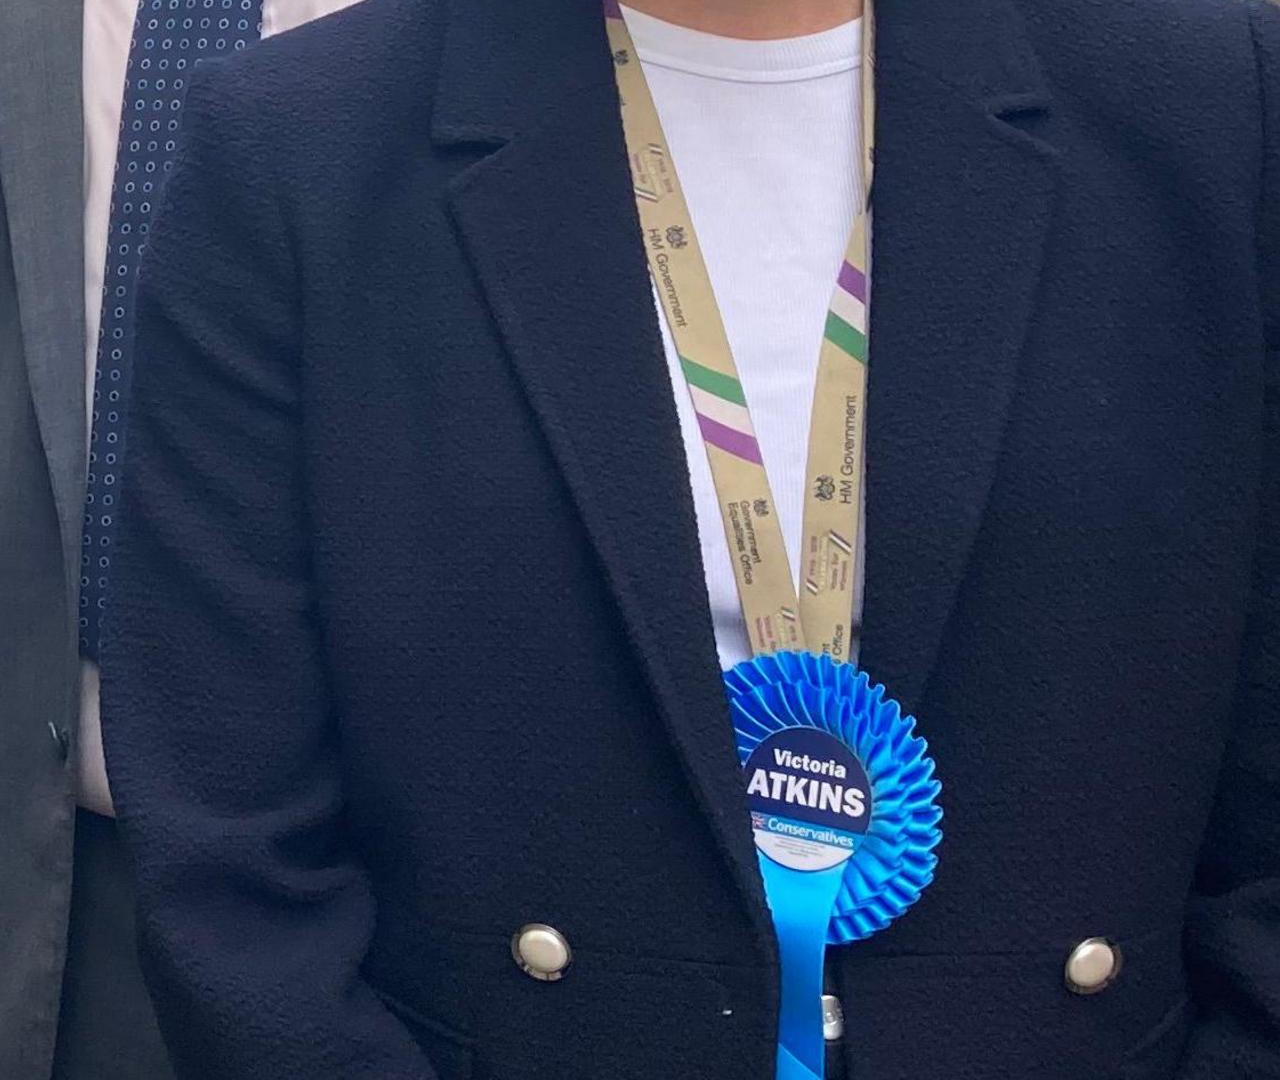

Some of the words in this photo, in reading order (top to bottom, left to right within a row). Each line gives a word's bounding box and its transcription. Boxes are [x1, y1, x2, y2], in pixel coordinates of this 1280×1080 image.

[648, 228, 665, 250] HM
[656, 252, 688, 328] Government
[840, 395, 857, 476] Government
[839, 480, 852, 504] HM
[740, 554, 753, 585] Office
[773, 748, 846, 779] Victoria
[747, 769, 865, 818] ATKINS
[767, 817, 854, 849] Conservatives
